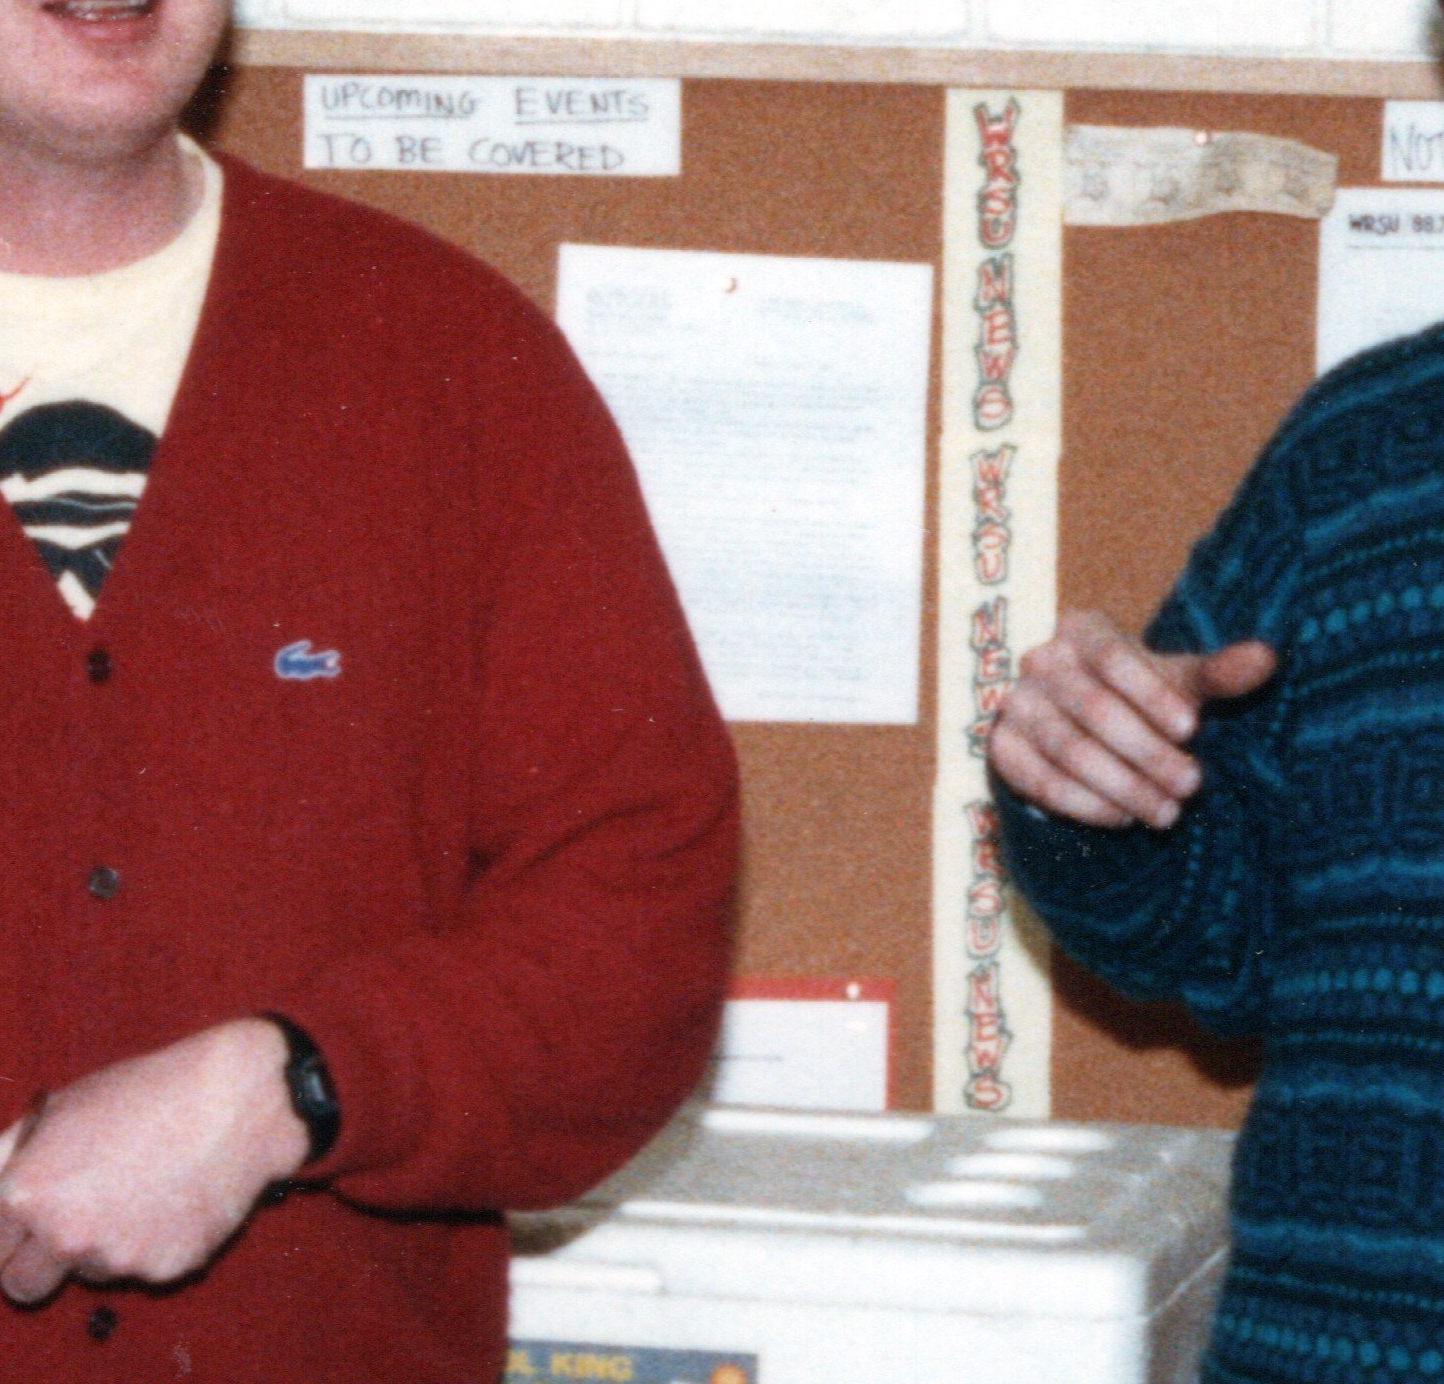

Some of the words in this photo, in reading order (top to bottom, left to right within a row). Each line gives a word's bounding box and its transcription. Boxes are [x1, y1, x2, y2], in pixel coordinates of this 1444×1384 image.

[321, 81, 480, 116] UPCOMING
[516, 86, 650, 117] EVENTS
[320, 132, 373, 165] TO
[395, 135, 444, 164] BE
[467, 137, 625, 170] COVERED
[1349, 214, 1400, 235] WRSU
